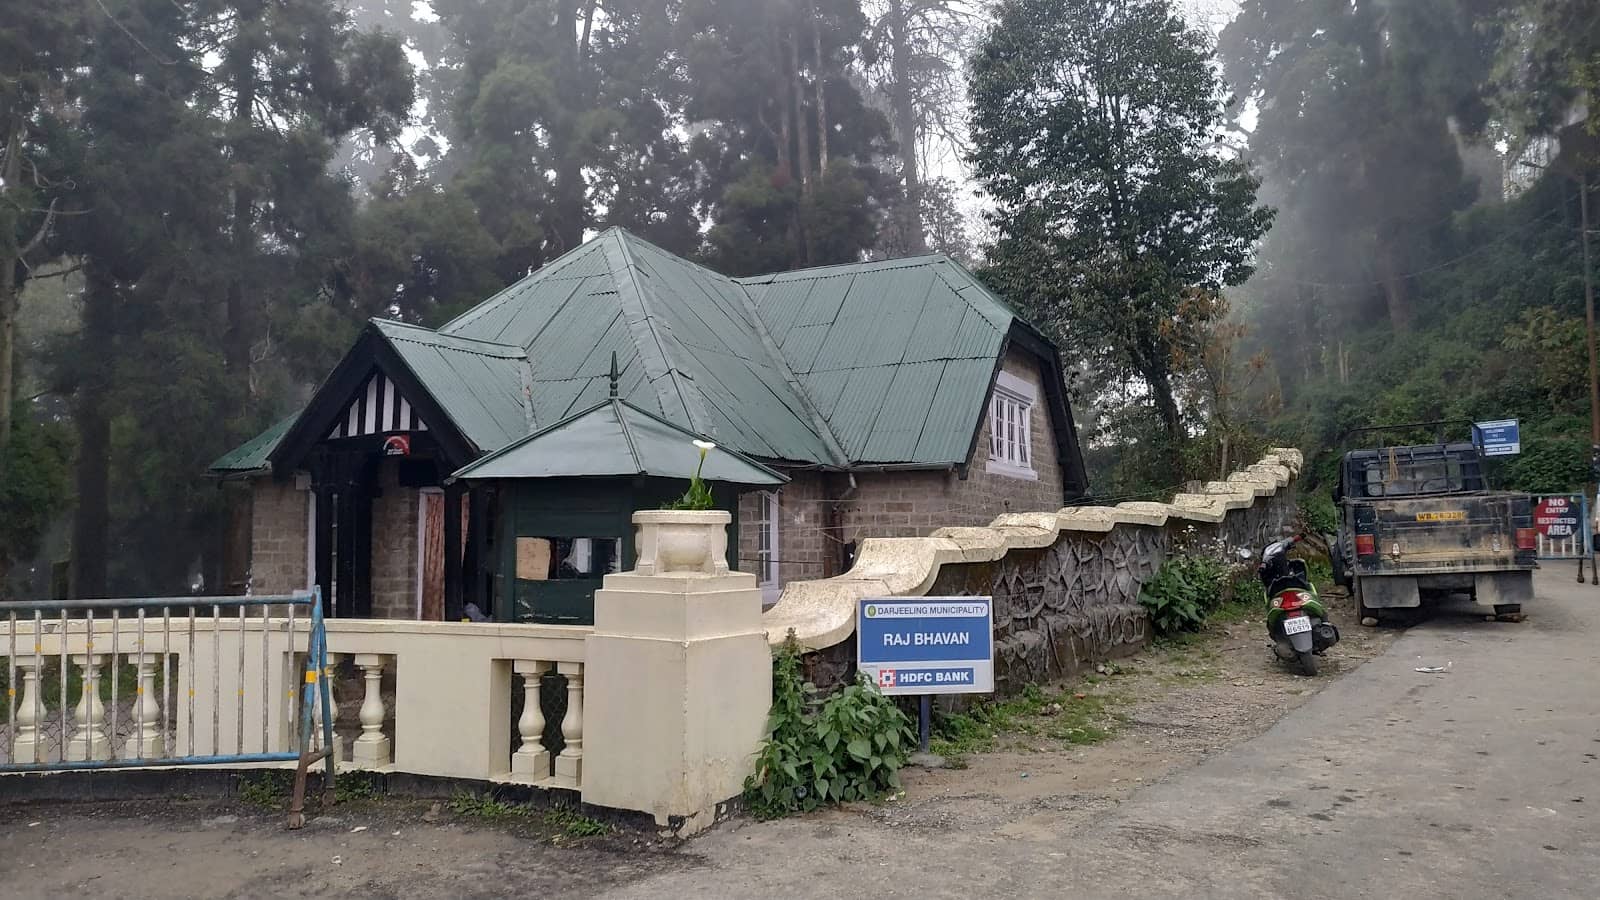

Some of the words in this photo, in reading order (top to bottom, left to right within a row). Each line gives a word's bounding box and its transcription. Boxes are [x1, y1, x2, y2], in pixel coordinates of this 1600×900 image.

[1548, 498, 1565, 506] NO
[1547, 525, 1572, 535] AREA
[877, 606, 928, 615] DARJEELING
[929, 606, 985, 614] MUNICIPALITY
[883, 633, 910, 646] RAJ
[914, 632, 970, 645] BHAVAN
[900, 672, 932, 683] HDFC
[935, 671, 970, 682] BANK
